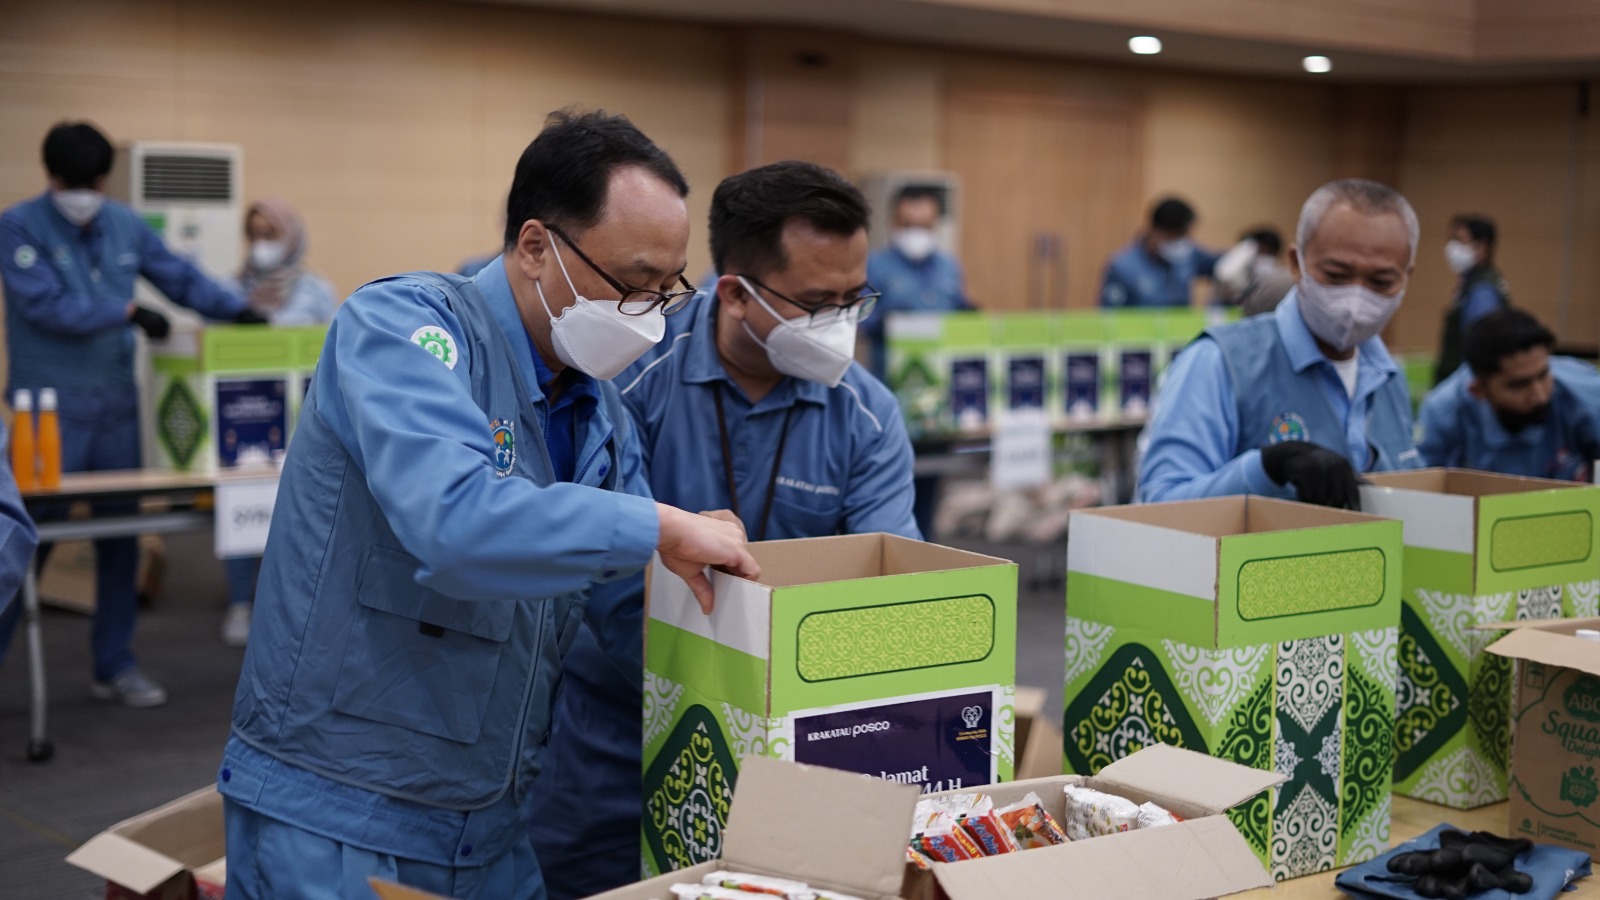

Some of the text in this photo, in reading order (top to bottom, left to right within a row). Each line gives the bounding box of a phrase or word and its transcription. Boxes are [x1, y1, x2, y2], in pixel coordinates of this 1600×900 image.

[1568, 691, 1600, 714] ABC
[807, 720, 890, 742] KRAKATAU posco
[863, 765, 929, 785] lamat
